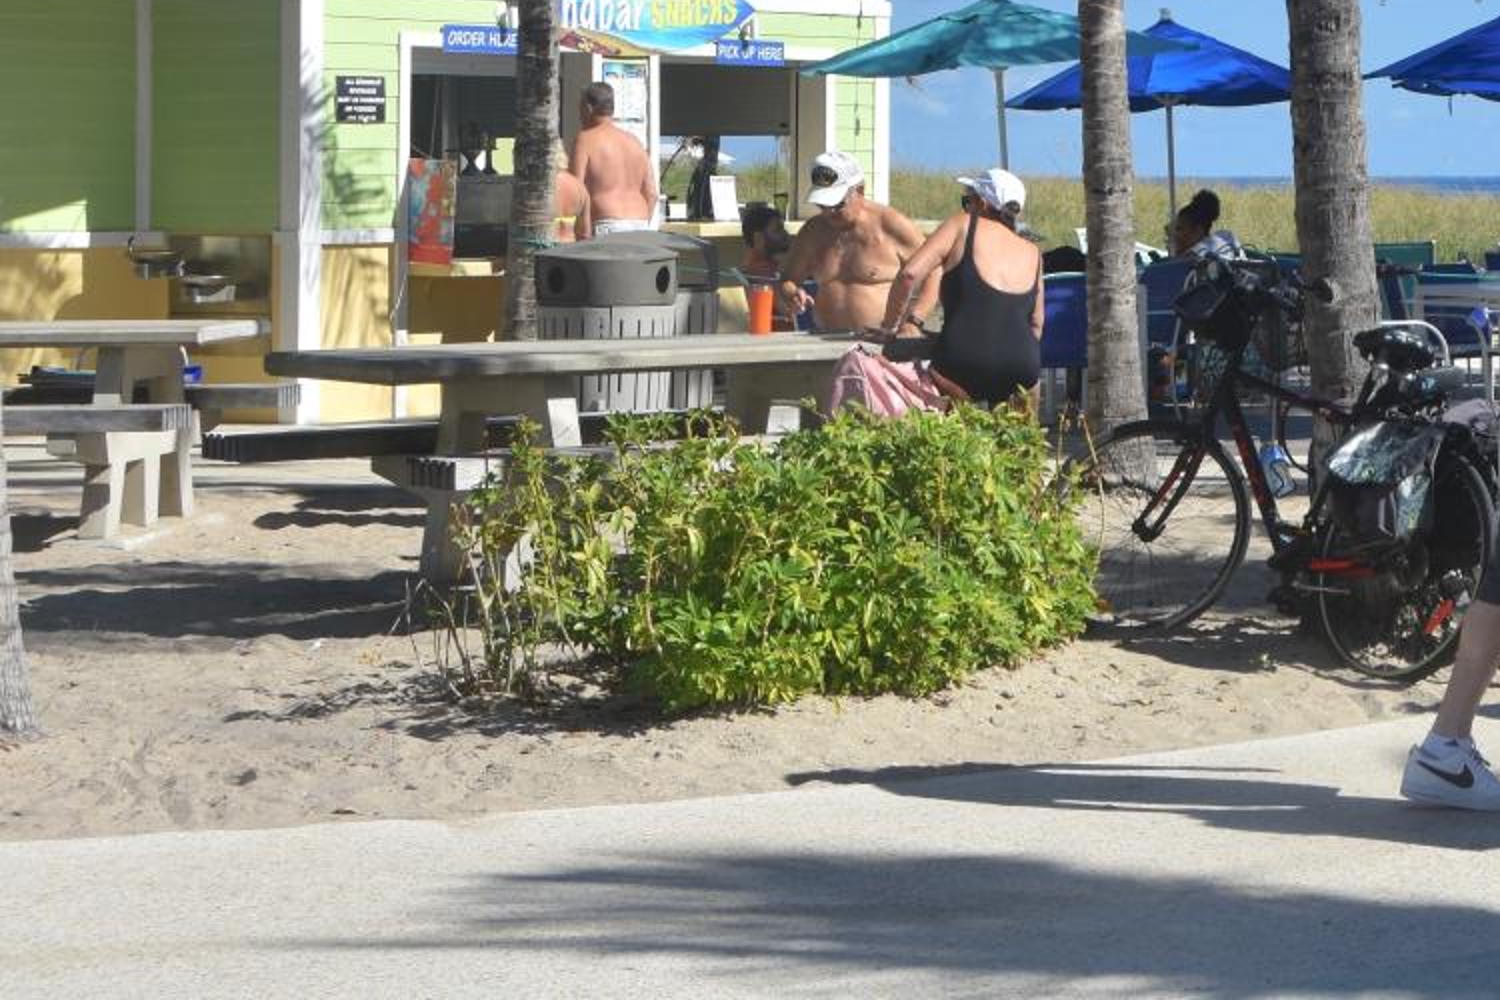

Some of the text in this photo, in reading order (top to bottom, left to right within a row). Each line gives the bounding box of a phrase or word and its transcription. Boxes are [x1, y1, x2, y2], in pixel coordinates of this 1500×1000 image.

[447, 29, 486, 47] ORDER
[719, 44, 740, 58] PICK
[758, 46, 783, 60] HERE
